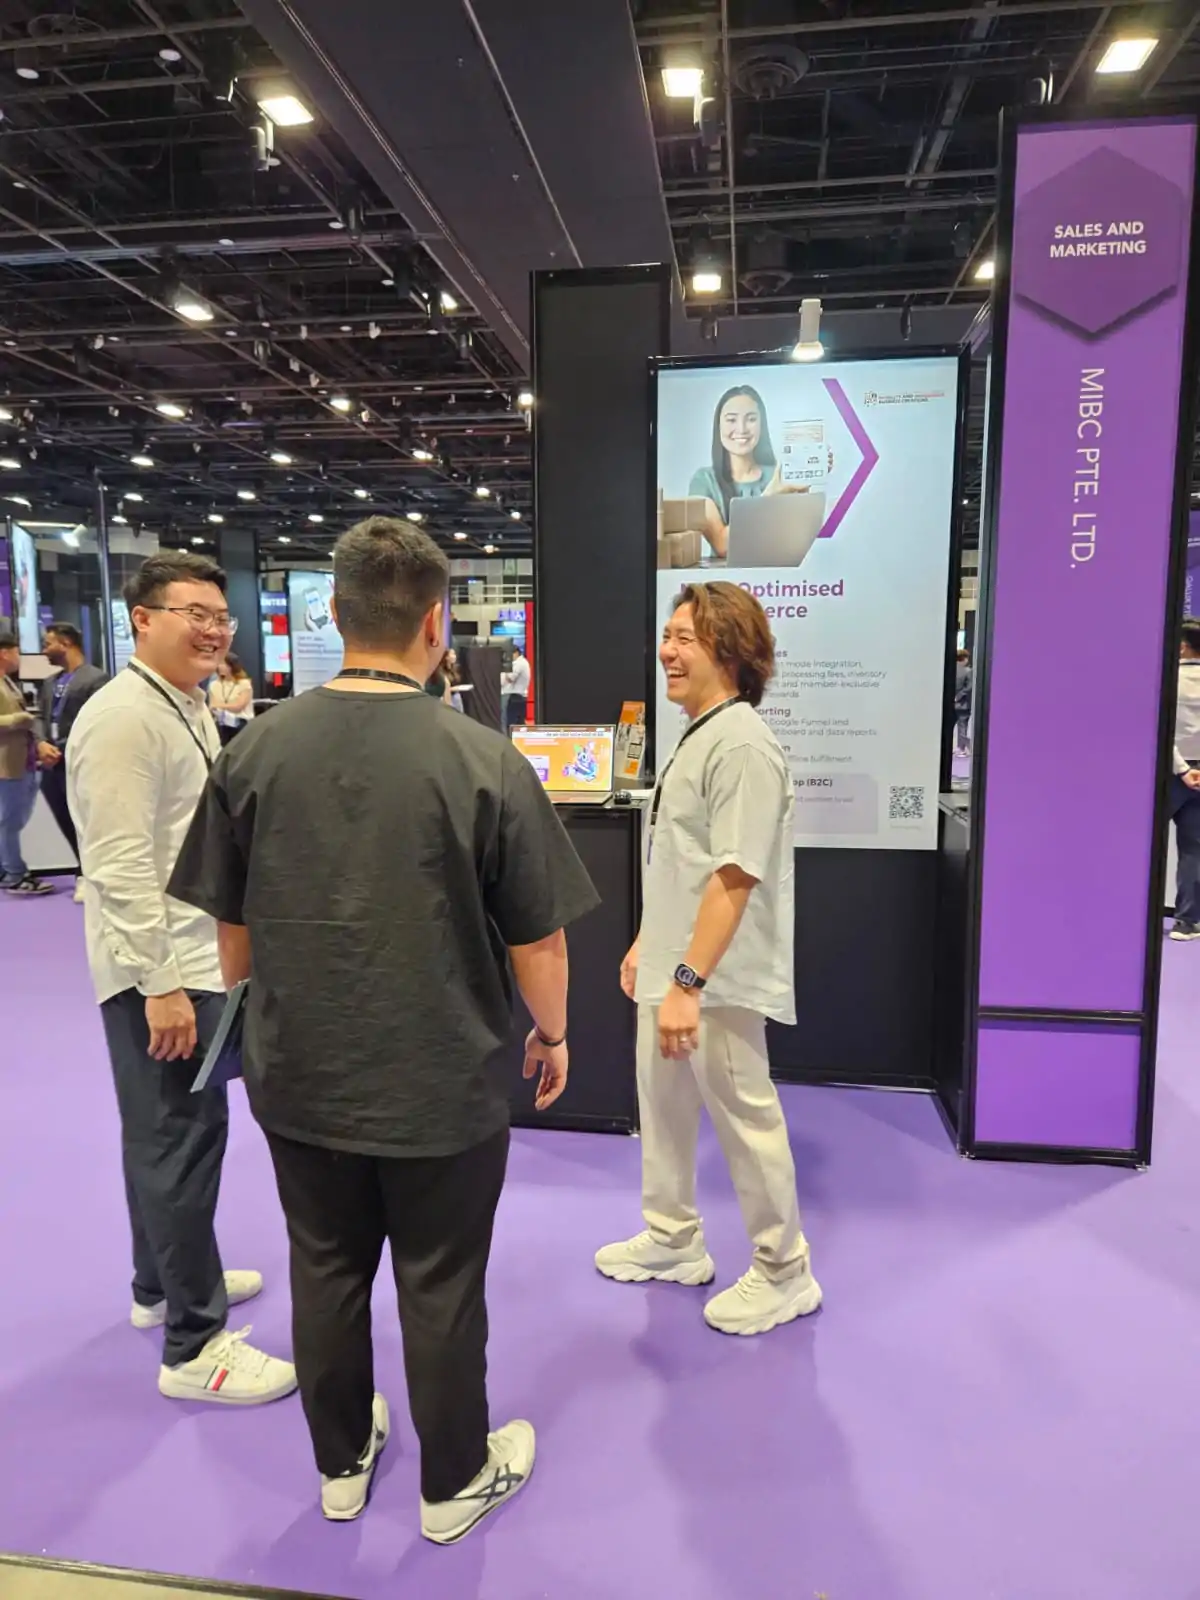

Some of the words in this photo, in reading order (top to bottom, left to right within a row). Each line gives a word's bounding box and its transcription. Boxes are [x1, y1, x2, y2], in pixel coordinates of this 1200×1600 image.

[1054, 222, 1103, 239] SALES
[1106, 221, 1144, 236] AND
[1049, 239, 1147, 258] MARKETING
[1076, 367, 1105, 439] MIBC
[1073, 448, 1100, 504] PTE.
[1070, 513, 1098, 569] LTD.
[738, 579, 844, 598] Optimised
[758, 706, 791, 718] orting
[807, 778, 833, 788] (B2C)
